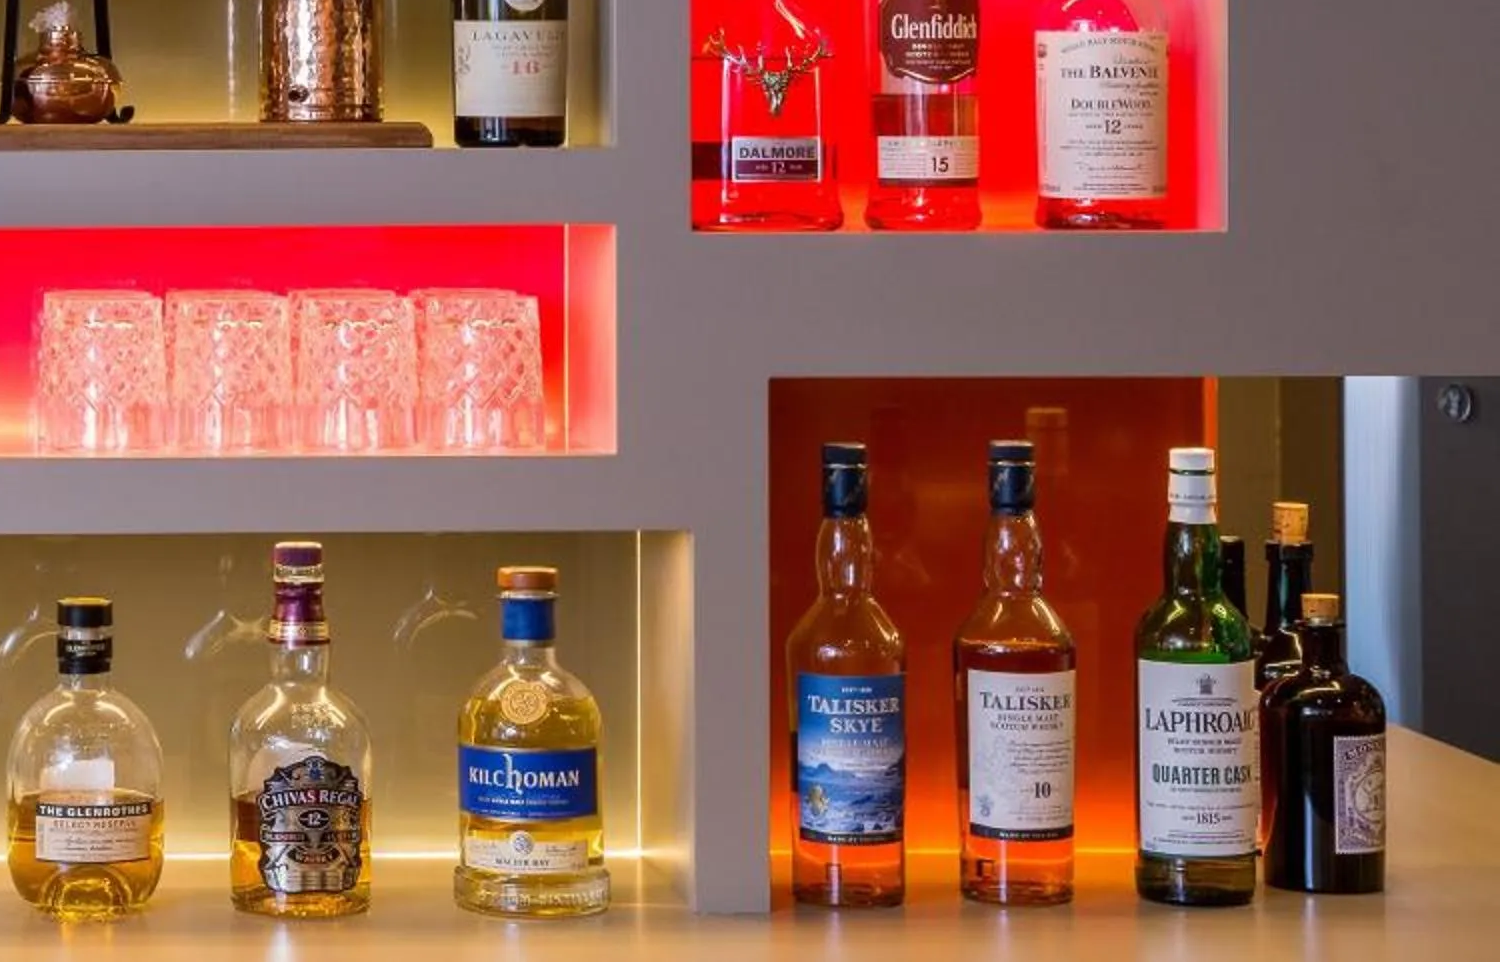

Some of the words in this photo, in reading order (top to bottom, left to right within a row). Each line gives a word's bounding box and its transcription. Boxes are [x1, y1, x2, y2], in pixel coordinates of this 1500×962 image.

[512, 61, 540, 75] 16
[1061, 68, 1086, 79] THE
[1089, 65, 1159, 79] BALVENIE
[1104, 119, 1122, 135] 12
[739, 146, 817, 159] DALMORE
[771, 161, 786, 174] 12
[931, 157, 949, 172] 15
[808, 694, 900, 715] TALISKER
[980, 691, 1071, 711] TALISKER
[830, 717, 883, 733] SKYE
[1153, 763, 1220, 785] QUARTER
[1034, 781, 1051, 799] 10
[262, 789, 316, 809] CHIVAS
[39, 805, 63, 817] THE
[67, 803, 149, 817] GLENROTHES
[307, 812, 322, 825] 12
